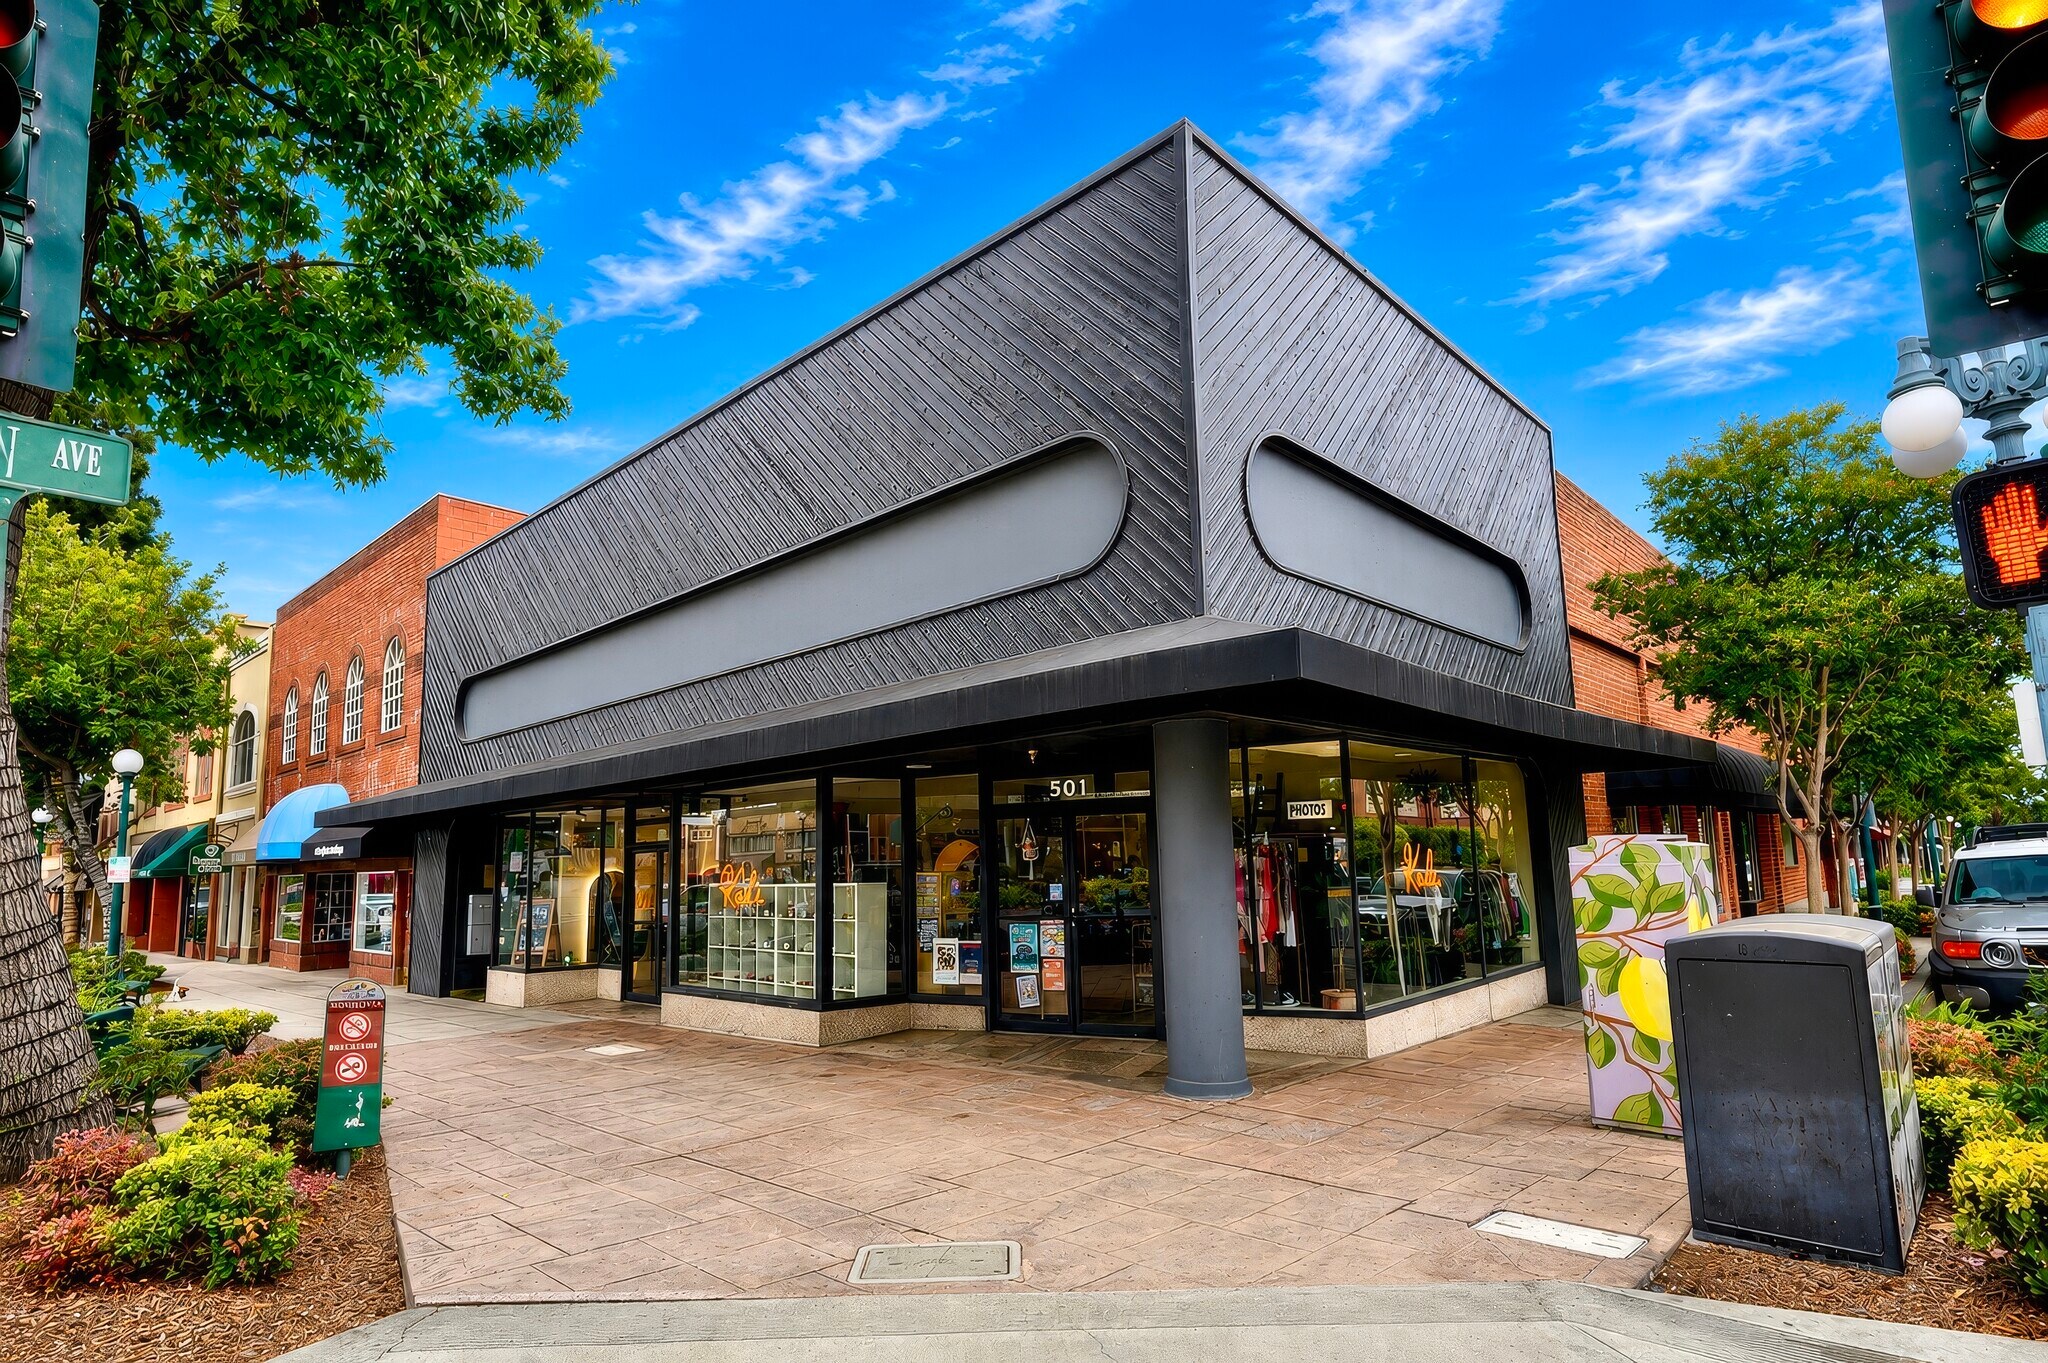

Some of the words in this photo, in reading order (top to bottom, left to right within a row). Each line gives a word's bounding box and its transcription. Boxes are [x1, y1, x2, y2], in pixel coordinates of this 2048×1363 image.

[51, 437, 103, 477] AVE
[1050, 778, 1087, 798] 501
[1289, 802, 1326, 818] PHOTOS
